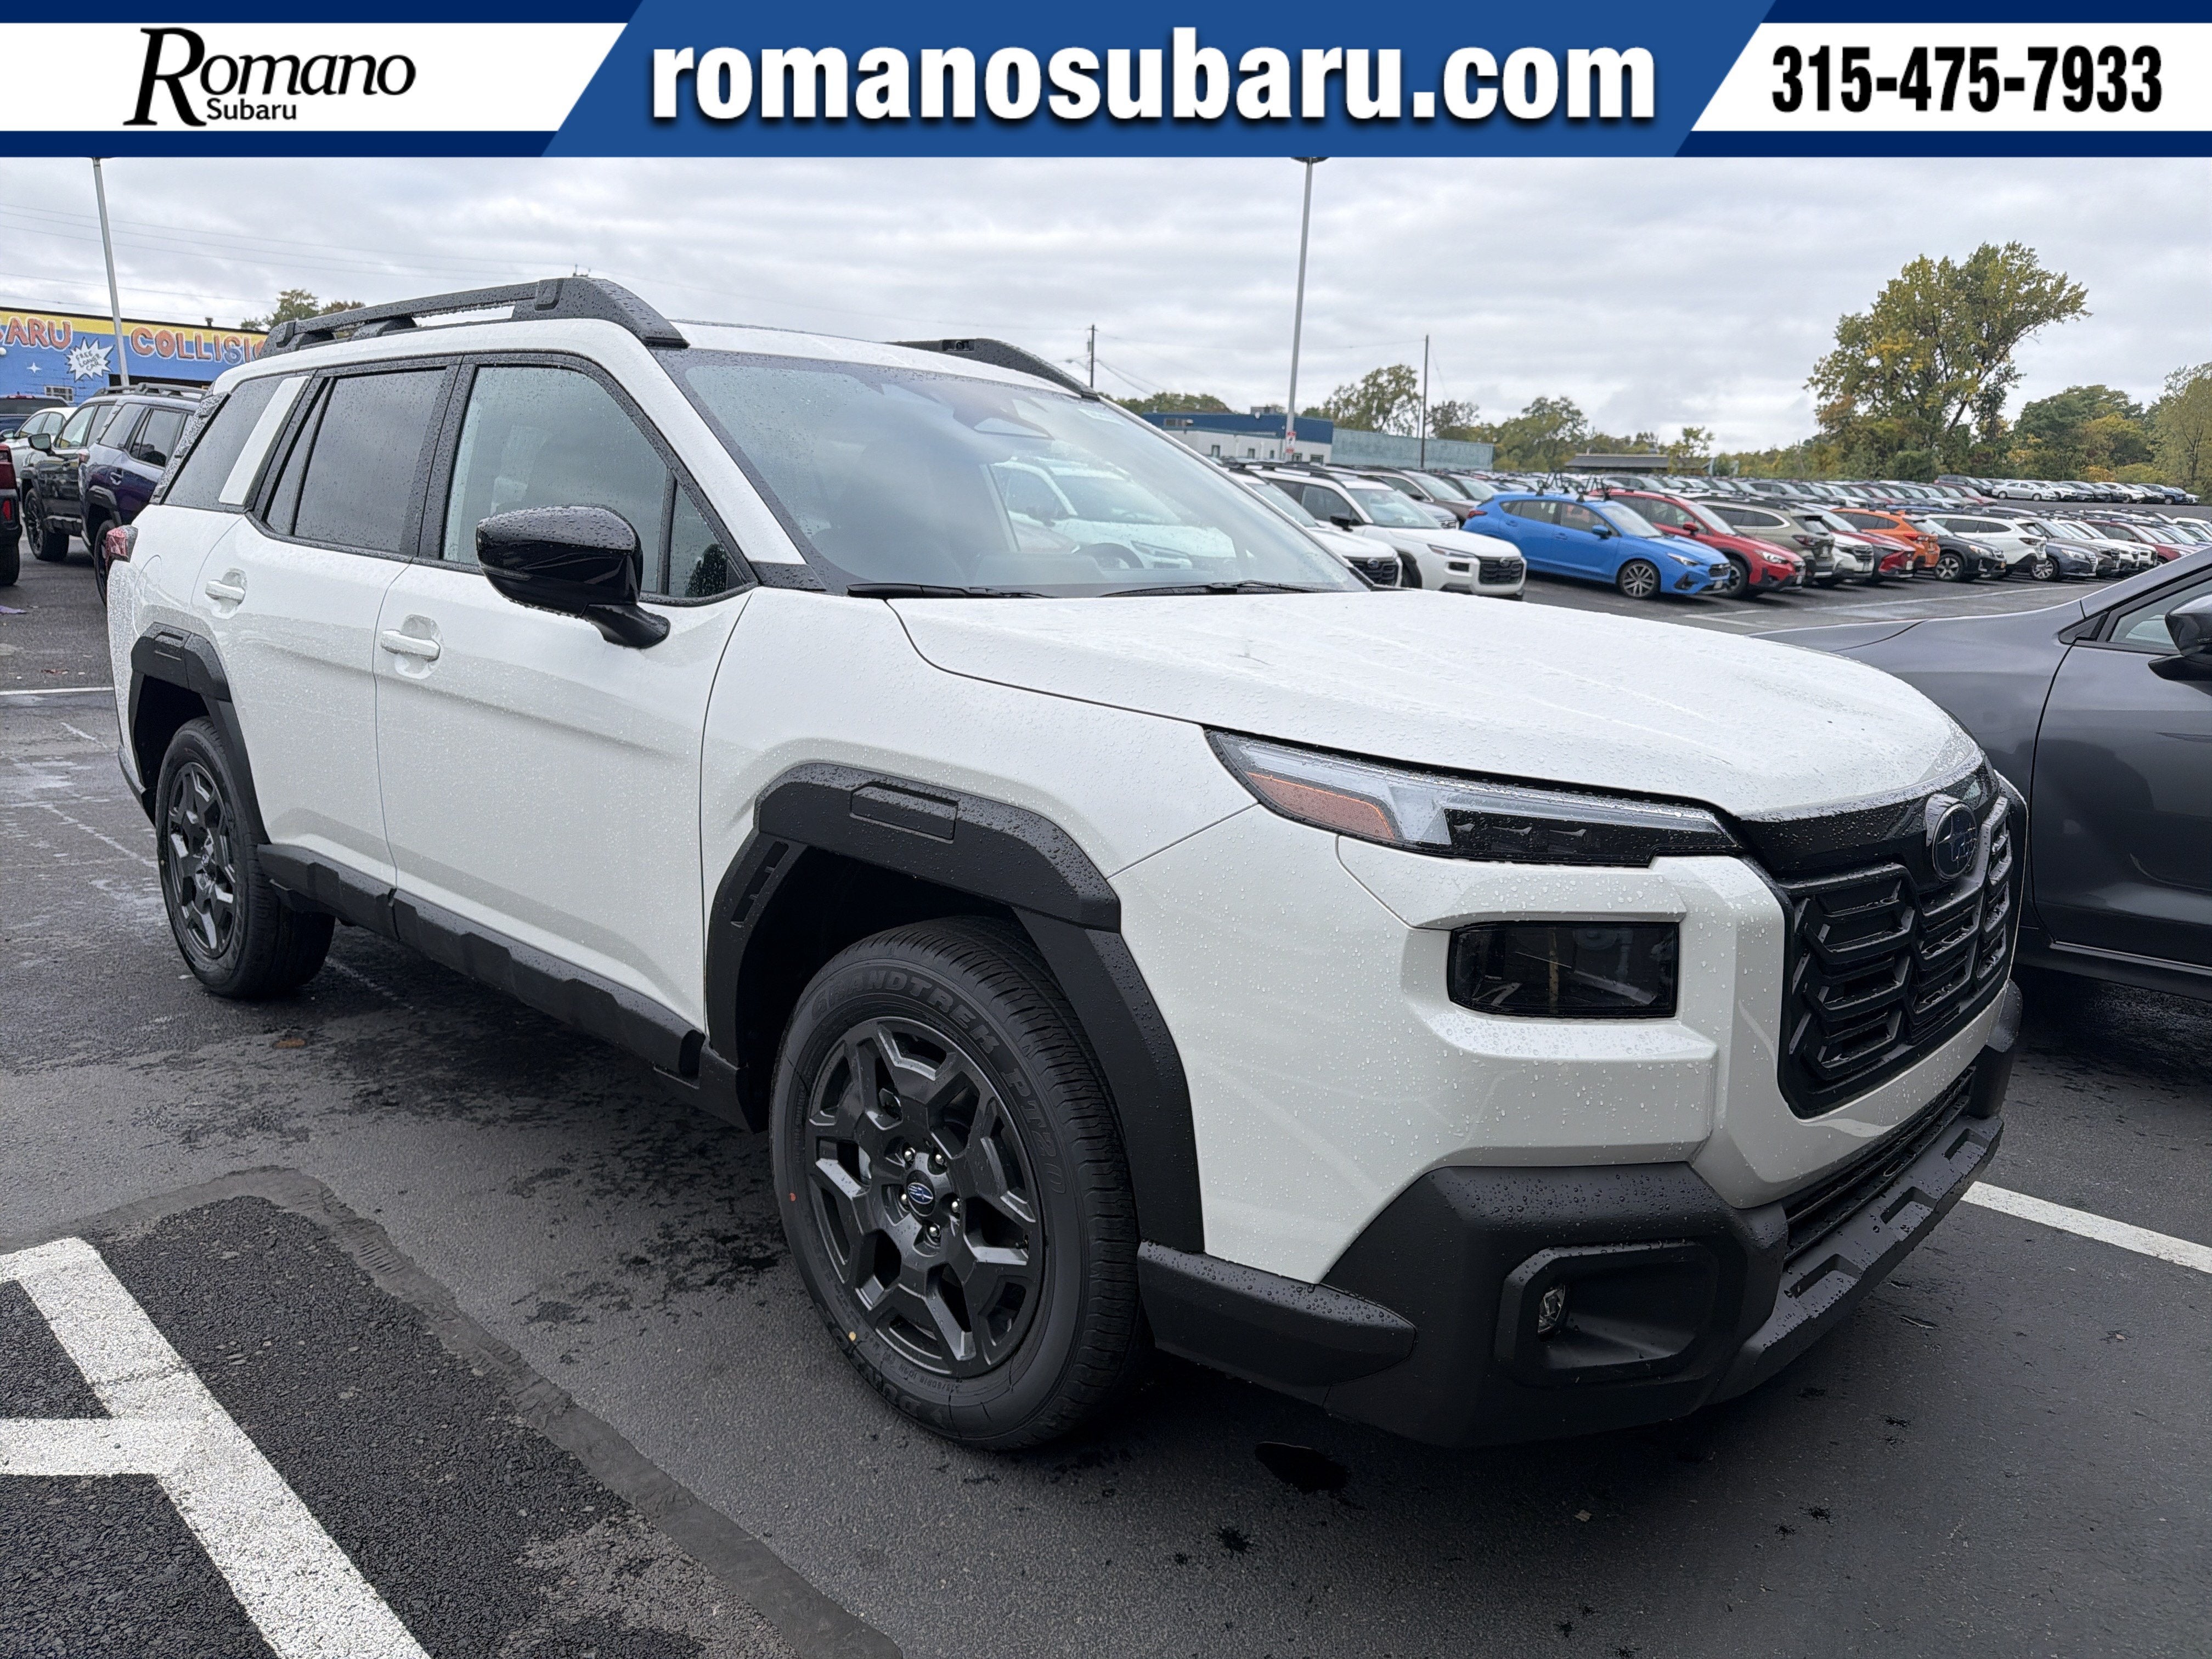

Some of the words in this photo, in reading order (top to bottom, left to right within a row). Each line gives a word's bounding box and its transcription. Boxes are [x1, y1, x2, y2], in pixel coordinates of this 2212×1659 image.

[0, 317, 72, 351] ARU
[76, 351, 93, 361] FREE
[86, 361, 101, 371] CAR
[811, 970, 1001, 1054] GRANDTREK
